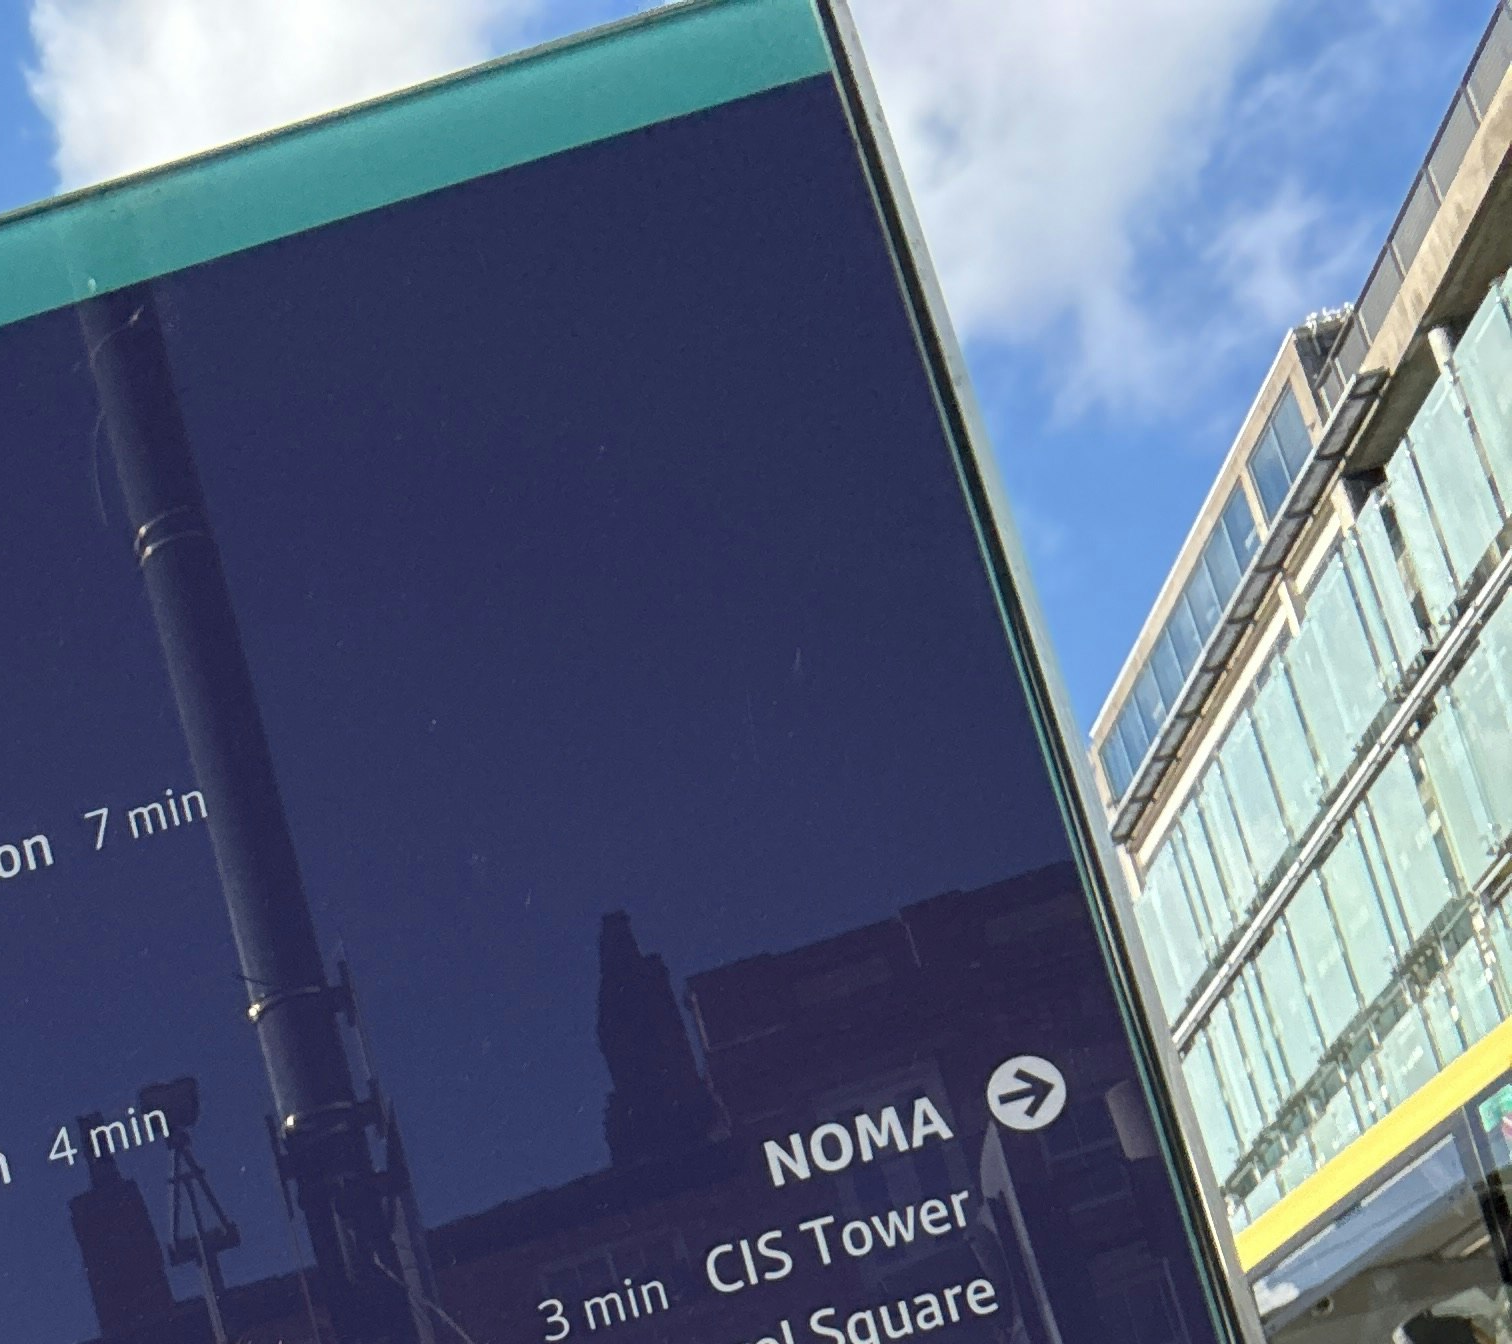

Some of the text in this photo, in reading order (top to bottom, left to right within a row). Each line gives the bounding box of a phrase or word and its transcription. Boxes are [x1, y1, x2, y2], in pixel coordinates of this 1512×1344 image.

[84, 808, 109, 851] 7
[127, 785, 208, 841] min
[48, 1126, 78, 1169] 4
[89, 1104, 171, 1162] min
[763, 1097, 954, 1187] NOMA
[538, 1188, 971, 1341] 3 min CIS Tower
